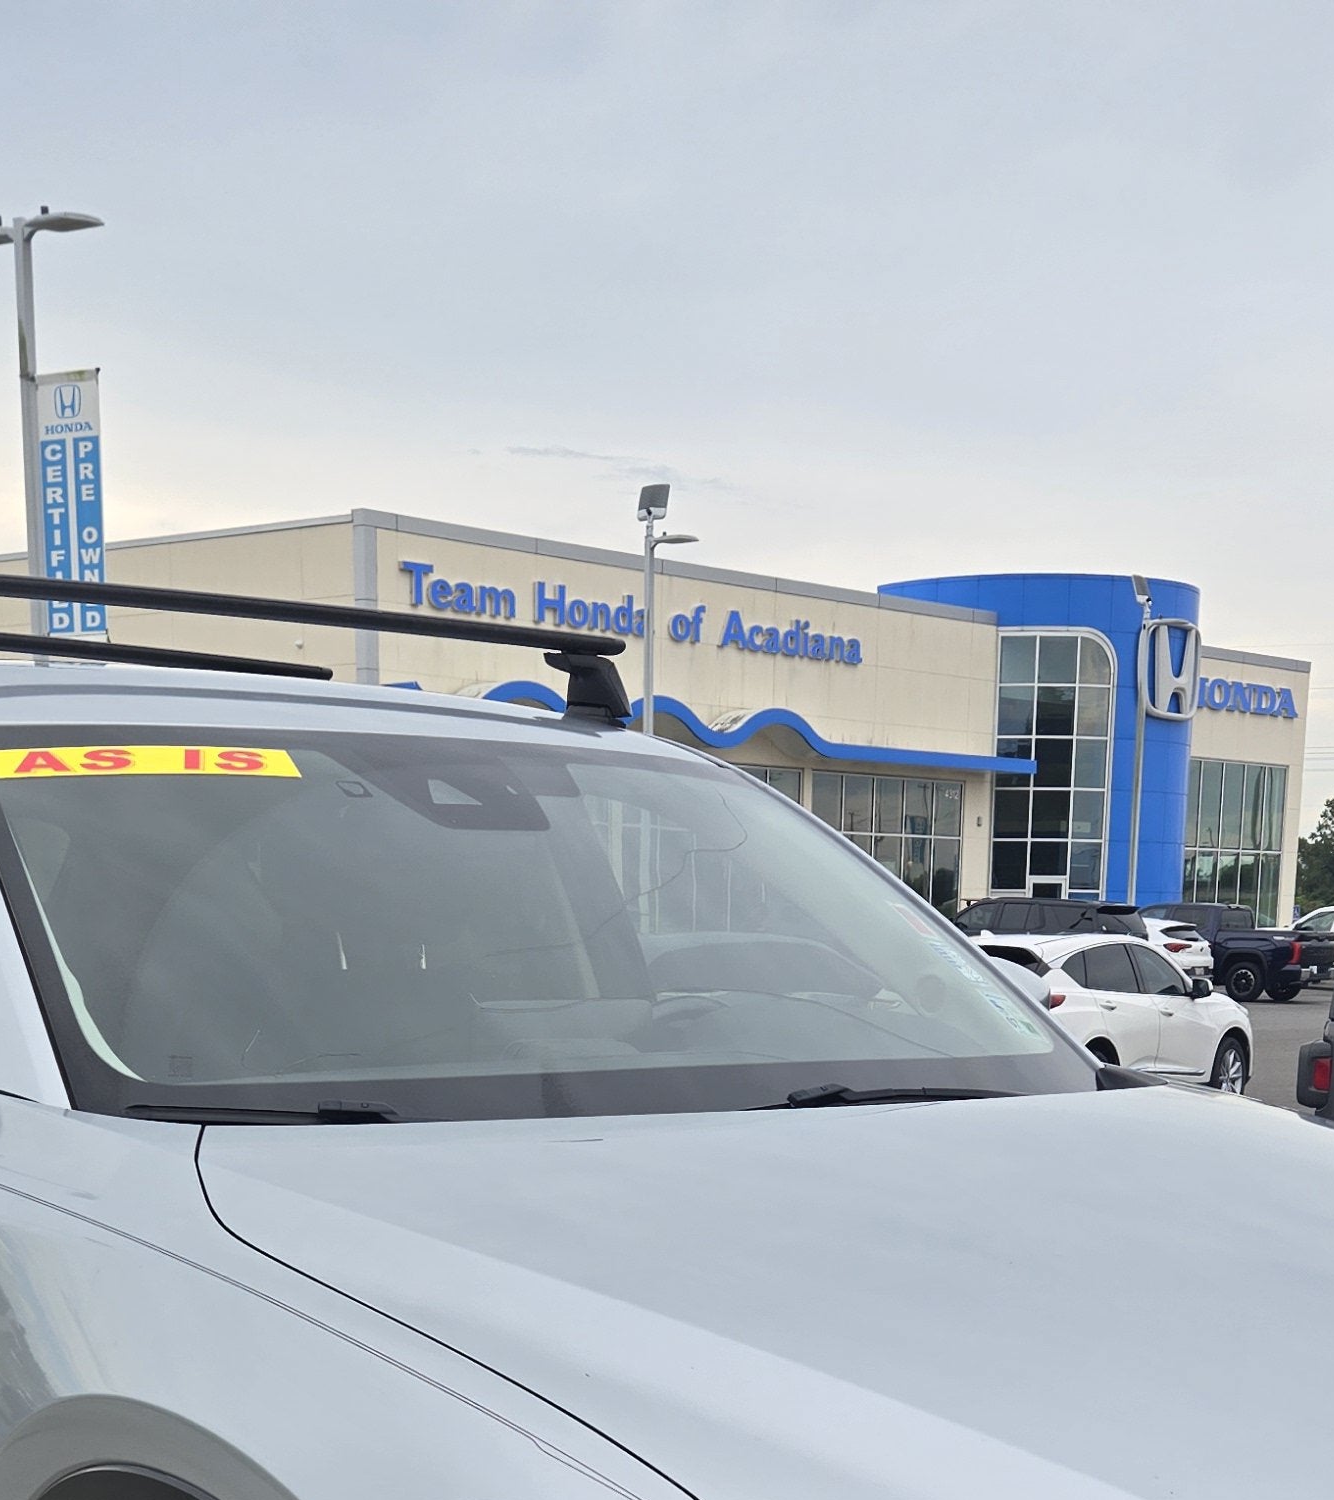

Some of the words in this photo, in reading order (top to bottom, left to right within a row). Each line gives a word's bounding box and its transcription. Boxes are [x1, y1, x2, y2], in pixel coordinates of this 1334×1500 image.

[45, 422, 93, 435] HONDA
[78, 441, 95, 501] PRE
[80, 526, 101, 627] OWND
[400, 560, 516, 619] Team
[670, 604, 706, 643] of
[720, 610, 863, 665] Acadiana
[14, 749, 134, 773] AS
[184, 749, 266, 771] IS
